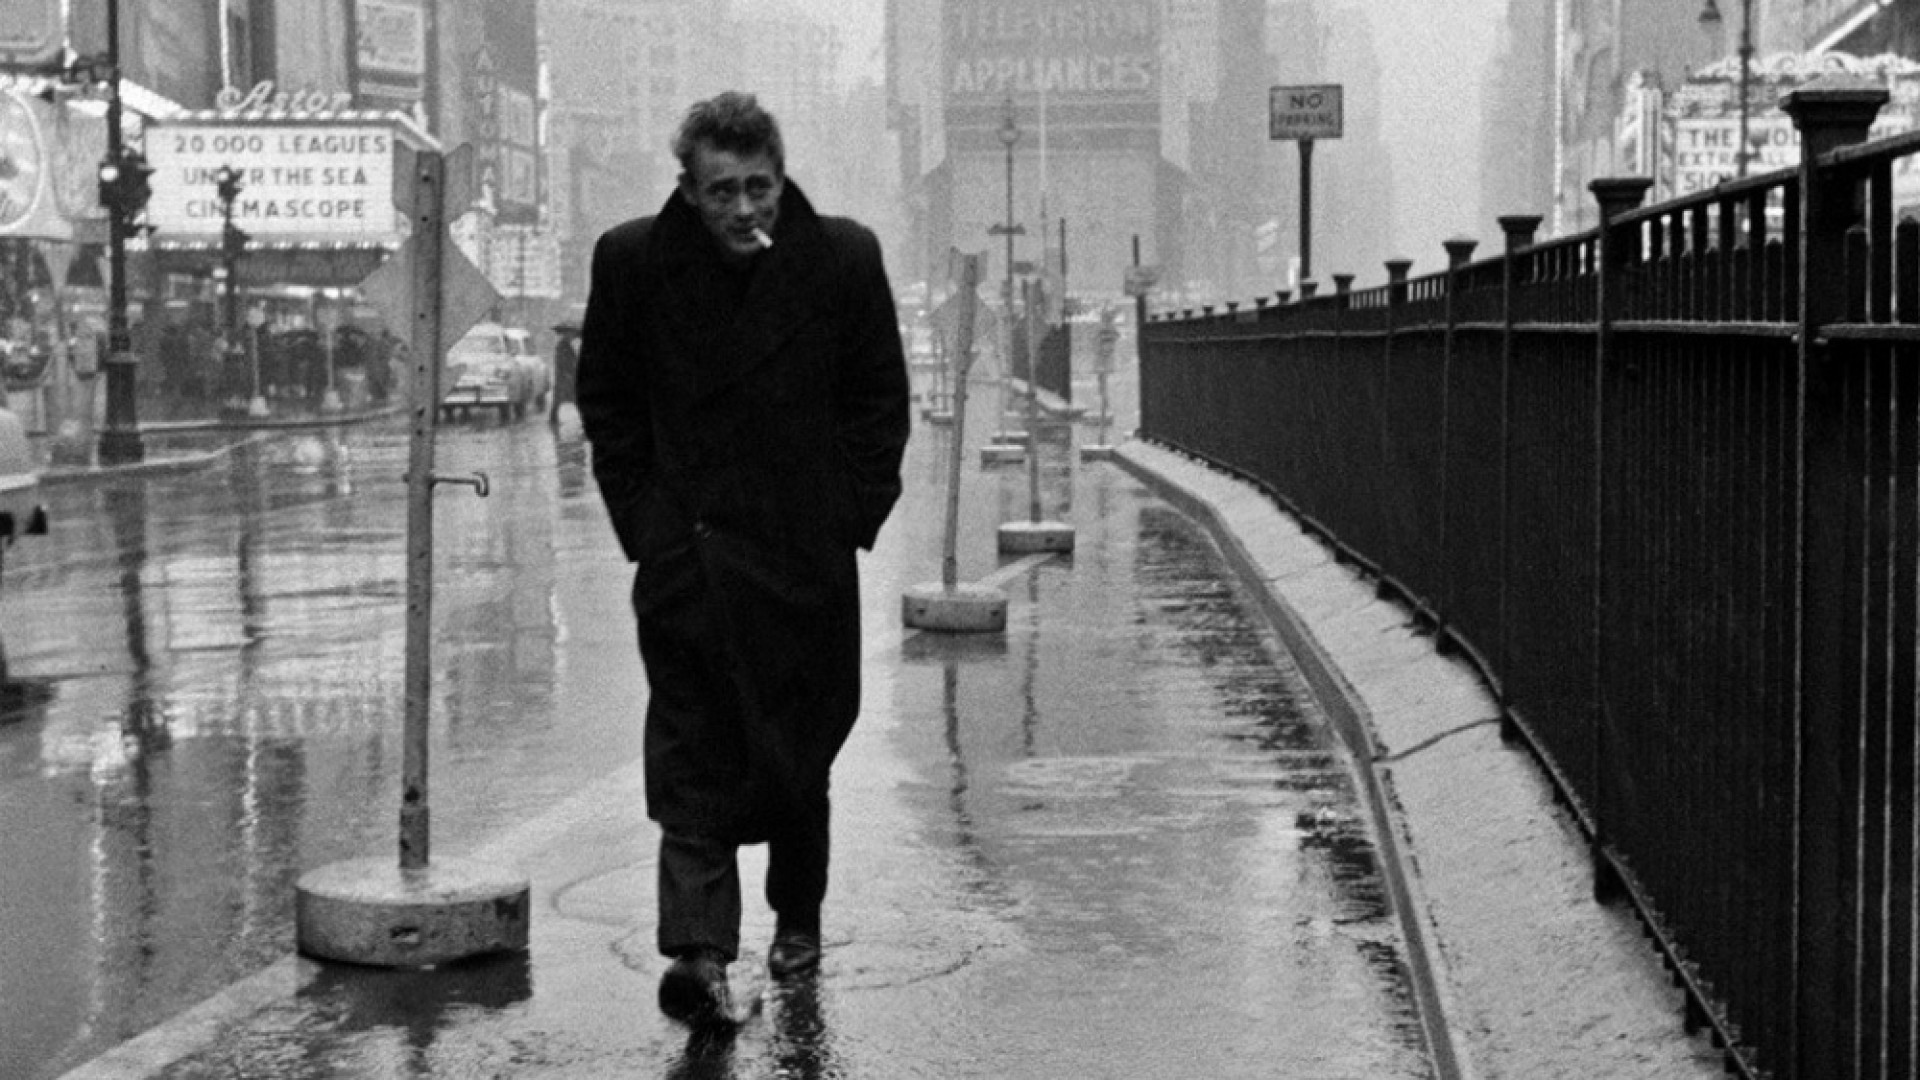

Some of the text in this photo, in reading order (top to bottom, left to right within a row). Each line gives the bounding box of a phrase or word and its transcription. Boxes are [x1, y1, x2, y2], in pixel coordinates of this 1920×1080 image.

[953, 55, 1151, 92] APPLIANCES
[216, 79, 352, 110] Astor
[1289, 93, 1323, 109] NO
[279, 135, 387, 154] LEAGUES
[1688, 128, 1733, 147] THE
[183, 167, 367, 185] UNR THE SEA
